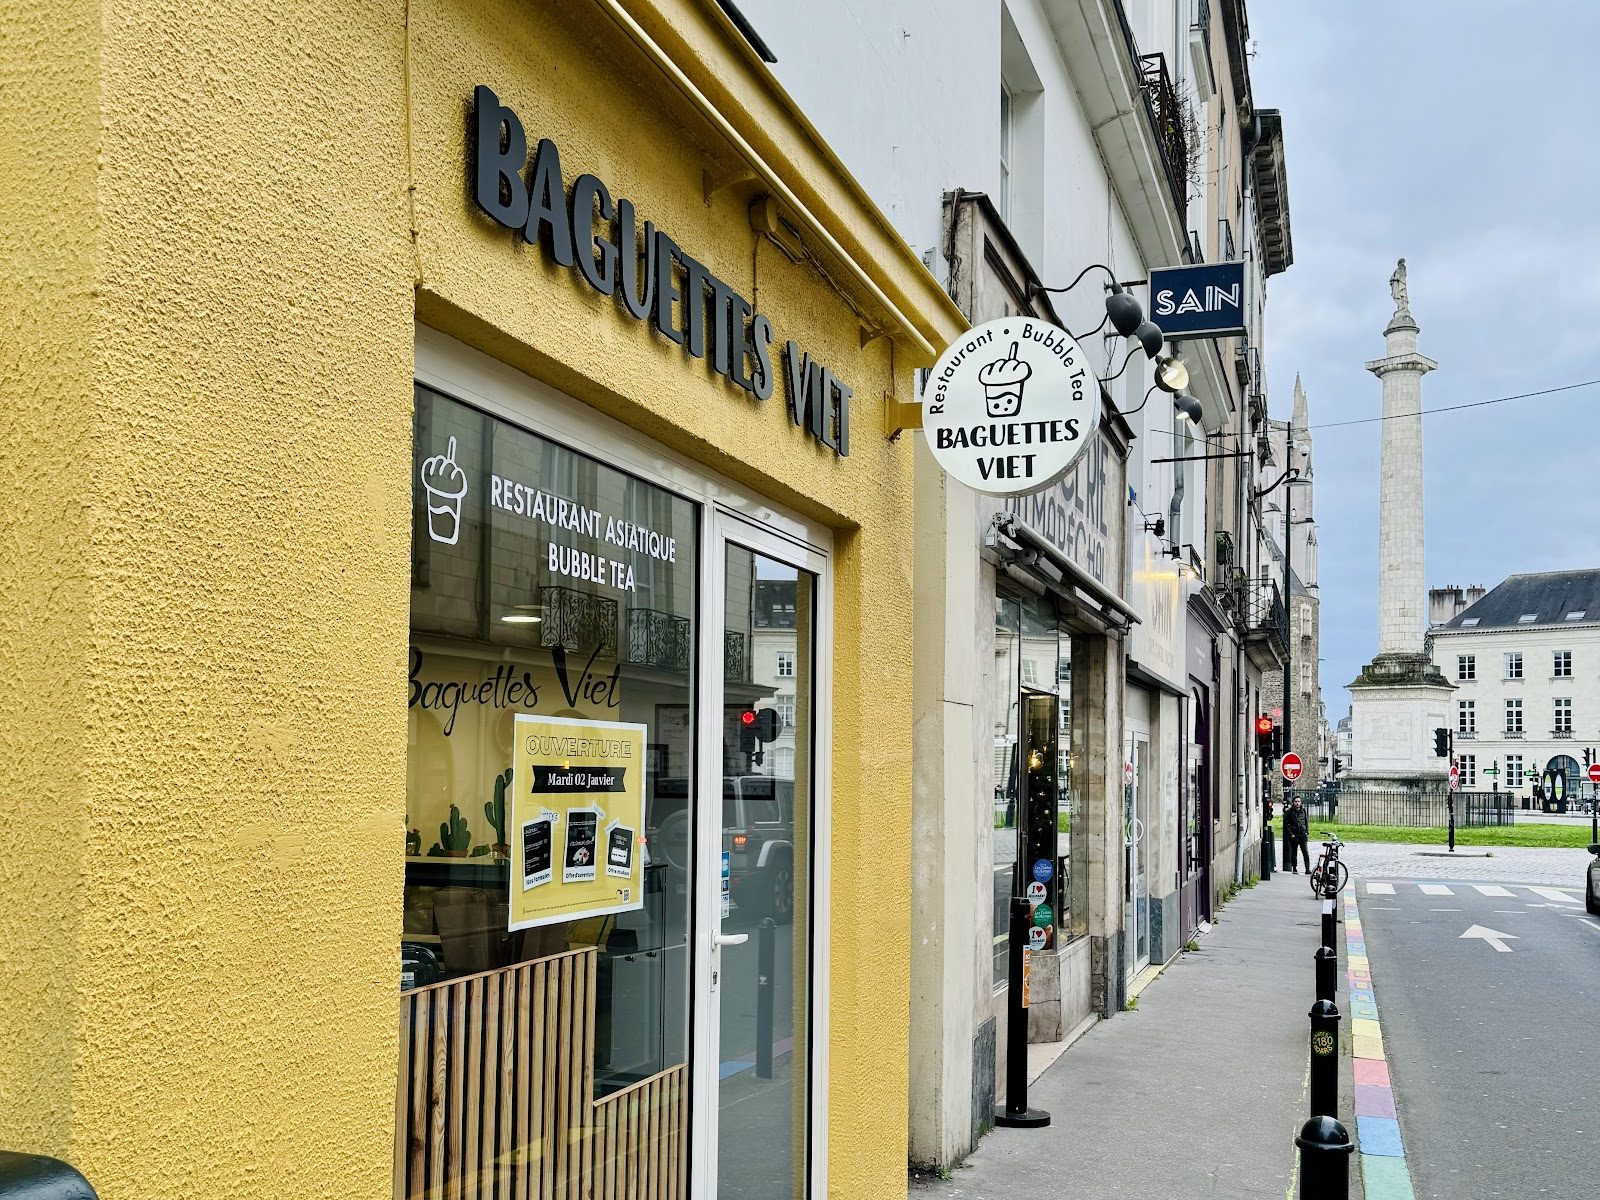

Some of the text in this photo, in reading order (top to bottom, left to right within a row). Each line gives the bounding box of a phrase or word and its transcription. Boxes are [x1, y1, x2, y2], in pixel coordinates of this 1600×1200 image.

[473, 84, 853, 457] BAGUETTES VIET
[1155, 283, 1239, 316] SAIN
[930, 323, 1086, 415] Restaurant Bubble Tea
[937, 418, 1080, 449] BAGUETTES
[976, 454, 1037, 480] VIET
[491, 475, 676, 563] RESTAURANT ASIATIQUE
[548, 542, 636, 593] BUBBLE TEA
[551, 642, 620, 708] Viet
[526, 735, 632, 758] OUVERTURE
[548, 773, 615, 788] Mardi 02 Janvier
[1316, 1036, 1333, 1047] 180
